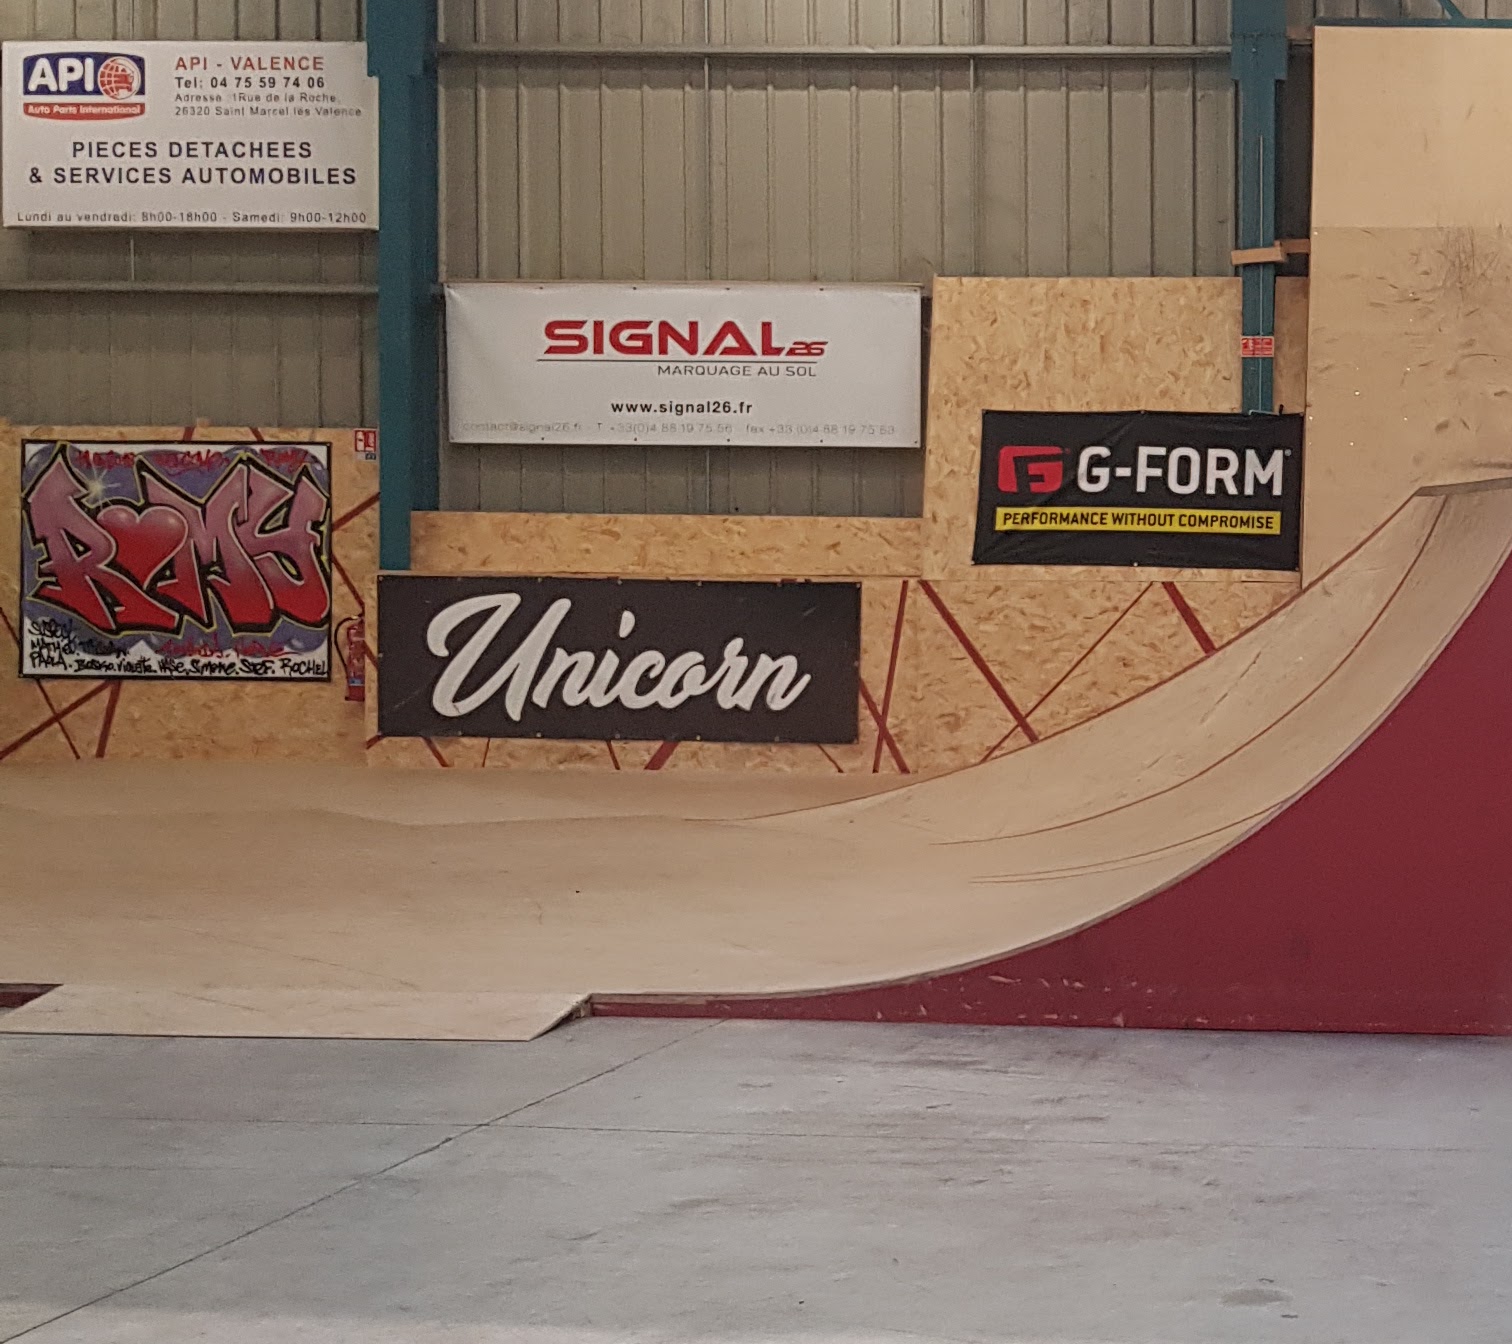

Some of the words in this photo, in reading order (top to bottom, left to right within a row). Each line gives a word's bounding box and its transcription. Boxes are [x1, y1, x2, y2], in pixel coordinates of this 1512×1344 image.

[175, 56, 208, 71] API
[231, 56, 325, 71] VALENCE
[28, 58, 95, 92] API
[175, 76, 203, 89] Tel:
[210, 76, 228, 89] 04
[235, 76, 252, 89] 75
[259, 76, 276, 89] 59
[283, 76, 301, 89] 74
[307, 76, 325, 89] 06
[266, 93, 280, 103] de
[284, 93, 295, 103] la
[28, 105, 50, 115] Auto
[53, 105, 77, 115] Parts
[79, 105, 141, 115] International
[175, 106, 210, 116] 26320
[215, 106, 245, 117] Saint
[250, 106, 289, 116] Marcel
[315, 107, 362, 117] Valence
[72, 141, 158, 158] PIECES
[168, 141, 313, 158] DETACHEES
[29, 167, 43, 184] &
[53, 167, 173, 185] SERVICES
[182, 167, 357, 185] AUTOMOBILES
[17, 212, 52, 222] Lundi
[57, 214, 72, 222] au
[290, 212, 367, 223] 9h00-12h00
[657, 364, 752, 377] MARQUAGE
[757, 365, 780, 377] AU
[785, 365, 817, 378] SOL
[611, 401, 754, 416] www.signal26.fr
[1002, 511, 1108, 527] PERFORMANCE
[1111, 513, 1175, 527] WITHOUT
[1178, 514, 1274, 529] COMPROMISE
[425, 592, 813, 722] Unicorn
